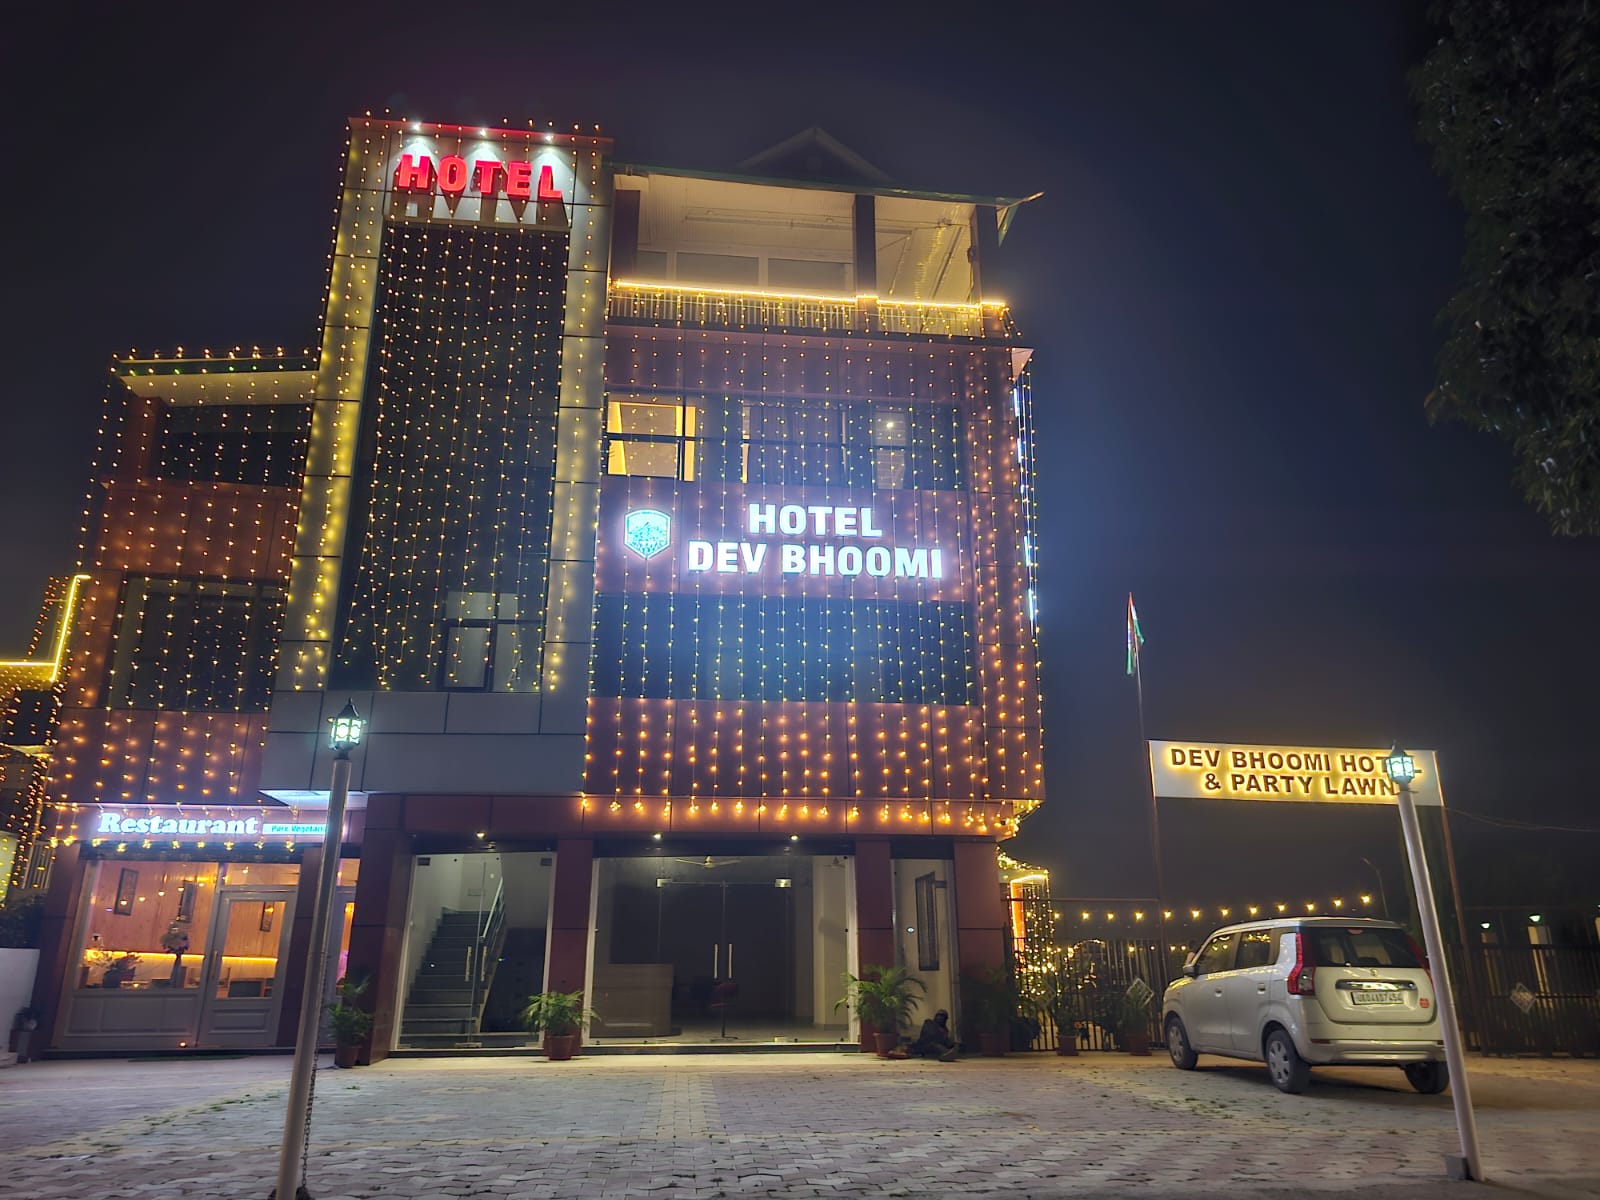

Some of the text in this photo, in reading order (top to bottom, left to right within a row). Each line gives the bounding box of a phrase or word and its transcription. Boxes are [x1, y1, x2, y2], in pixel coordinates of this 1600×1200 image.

[398, 154, 562, 198] HOTEL
[749, 503, 882, 537] HOTEL
[688, 540, 943, 579] DEV BHOOMI
[1171, 748, 1221, 768] DEV
[1231, 751, 1331, 772] BHOOMI
[1204, 773, 1395, 796] & PARTY LAWN
[98, 812, 258, 834] Restaurant
